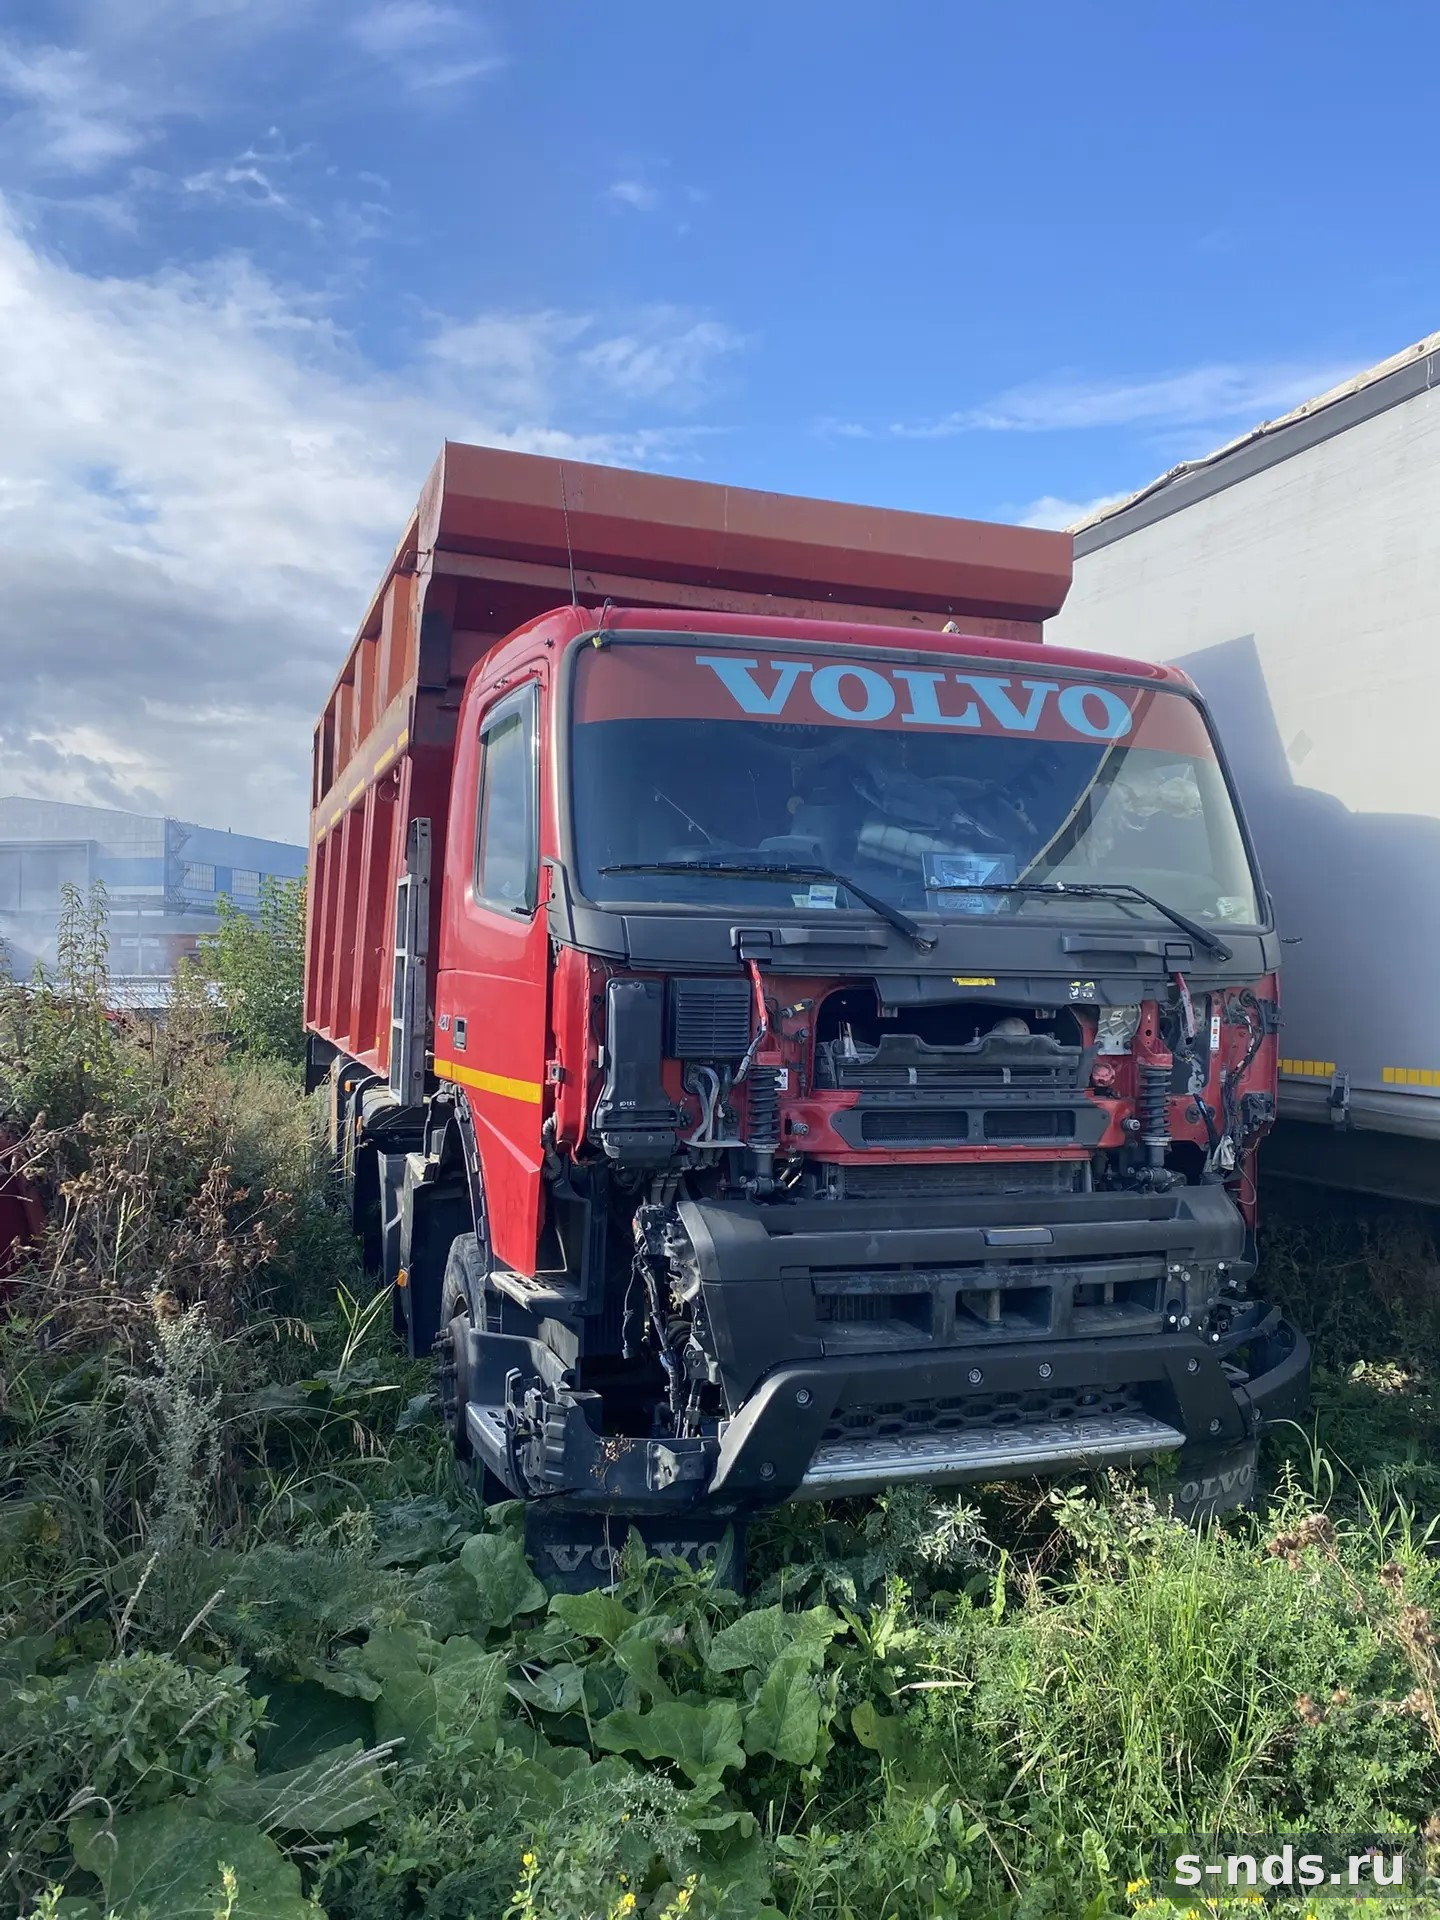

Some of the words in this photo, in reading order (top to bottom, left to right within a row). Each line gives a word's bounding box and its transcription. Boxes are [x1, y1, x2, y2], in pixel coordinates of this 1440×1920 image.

[695, 655, 1134, 739] VOLVO
[1179, 1463, 1252, 1504] OLVO
[543, 1541, 721, 1572] VOVO
